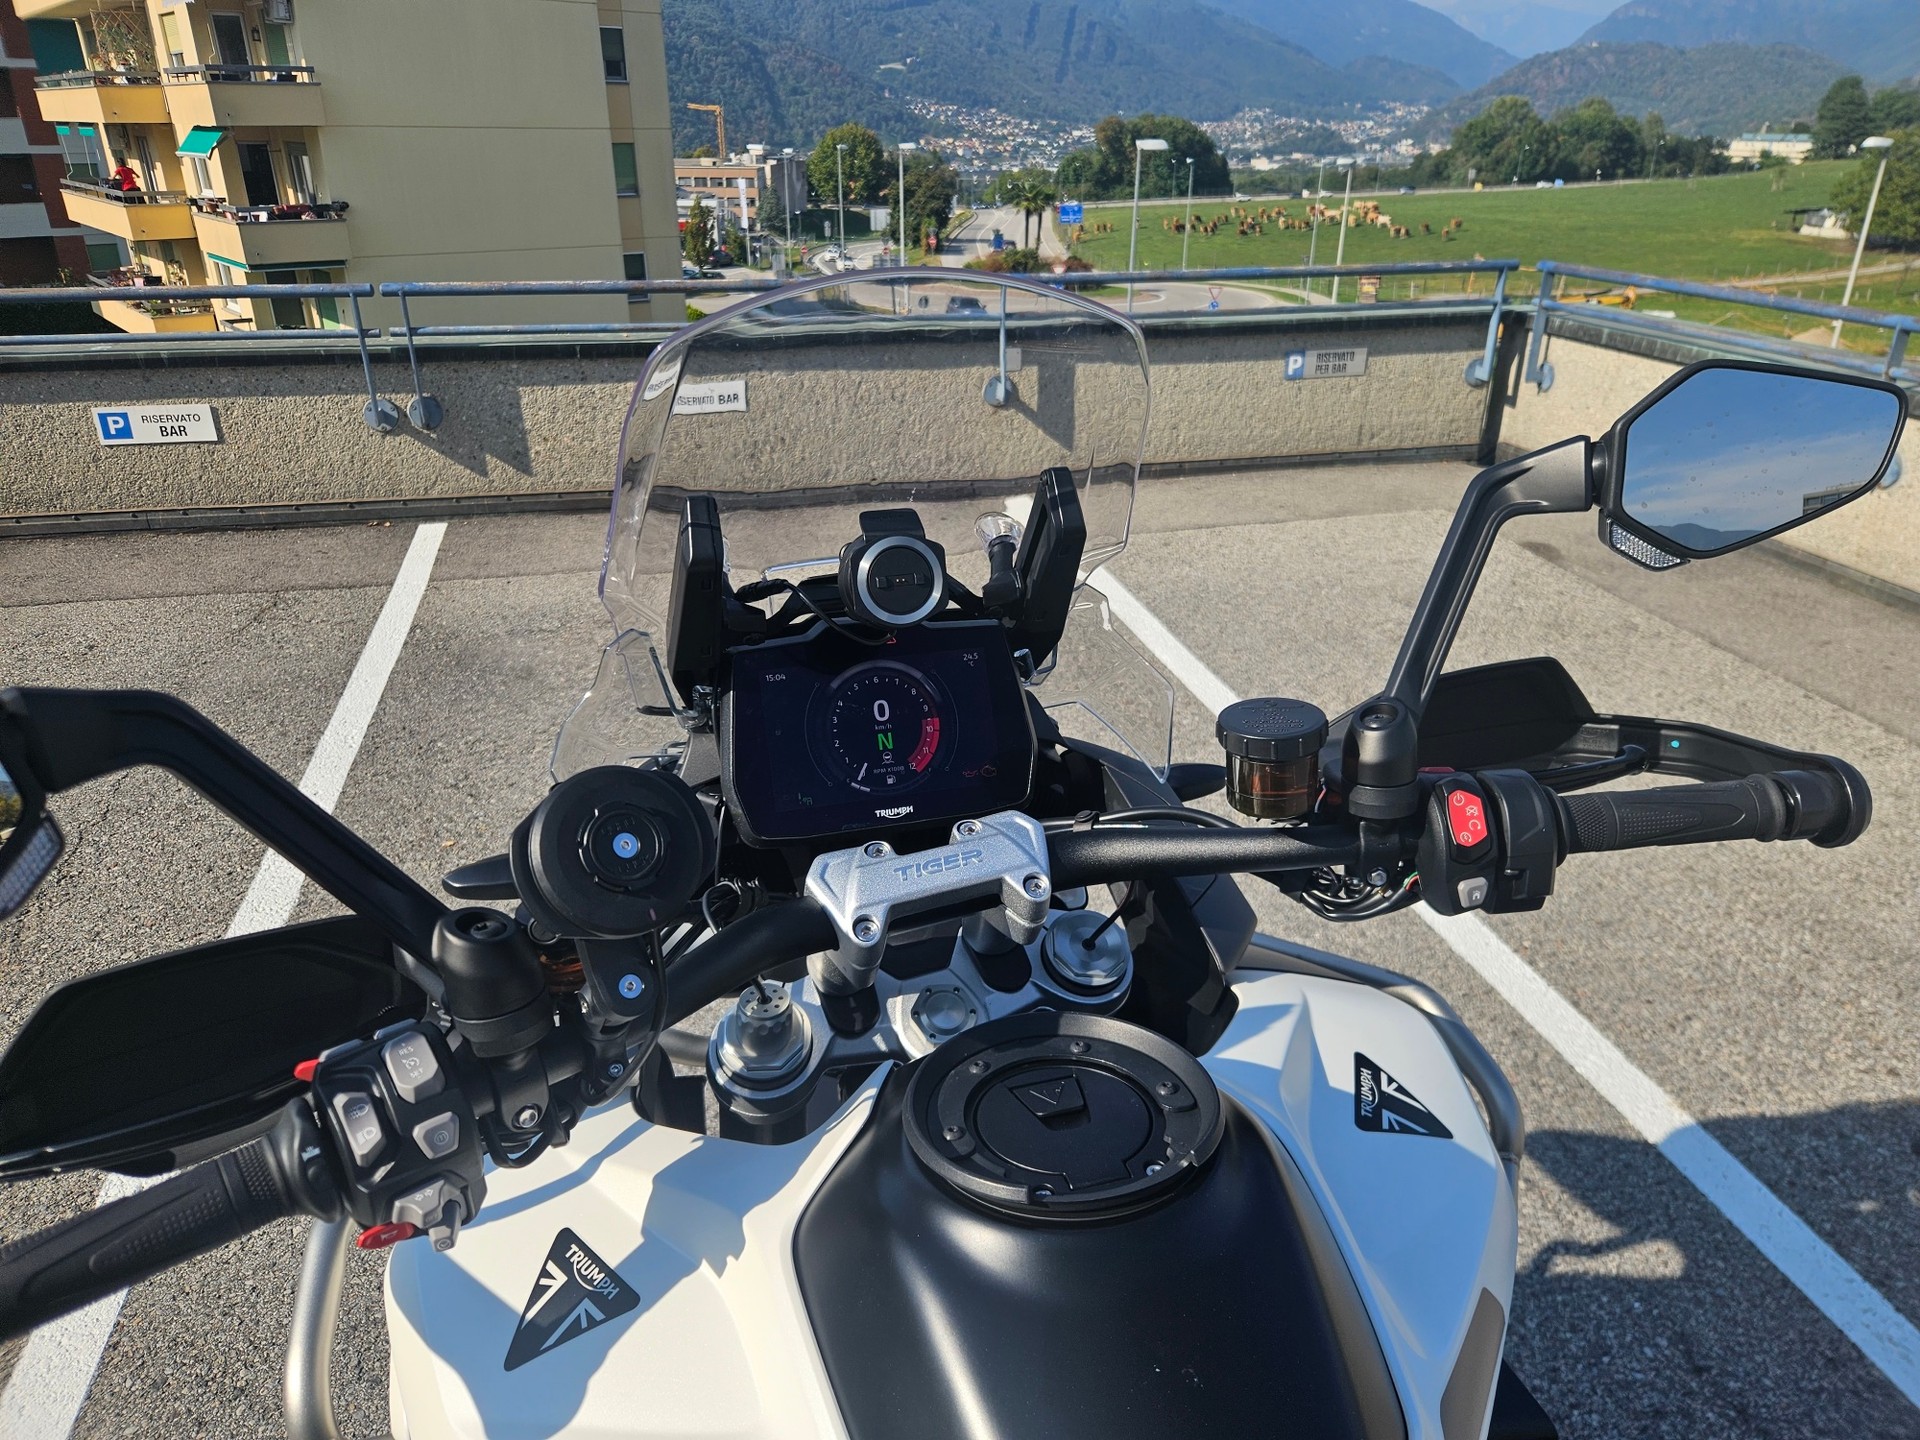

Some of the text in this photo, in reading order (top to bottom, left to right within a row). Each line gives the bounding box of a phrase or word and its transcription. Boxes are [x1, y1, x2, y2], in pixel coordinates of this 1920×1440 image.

[1316, 351, 1355, 364] RISERVATO
[1314, 363, 1347, 375] PER BAR
[718, 393, 740, 405] BAR
[141, 413, 201, 424] RISERVATO
[106, 416, 125, 435] P
[159, 425, 188, 437] BAR
[765, 673, 786, 682] 15:04
[873, 699, 890, 722] 0
[874, 723, 893, 731] km/h
[926, 725, 934, 733] 10
[877, 732, 894, 751] N
[923, 746, 930, 754] 11
[908, 762, 917, 770] 12
[874, 805, 914, 819] TRIUMPH
[893, 850, 983, 882] TIGER
[1359, 1067, 1379, 1118] TRIUMPH
[565, 1243, 620, 1300] TRIUMPH
